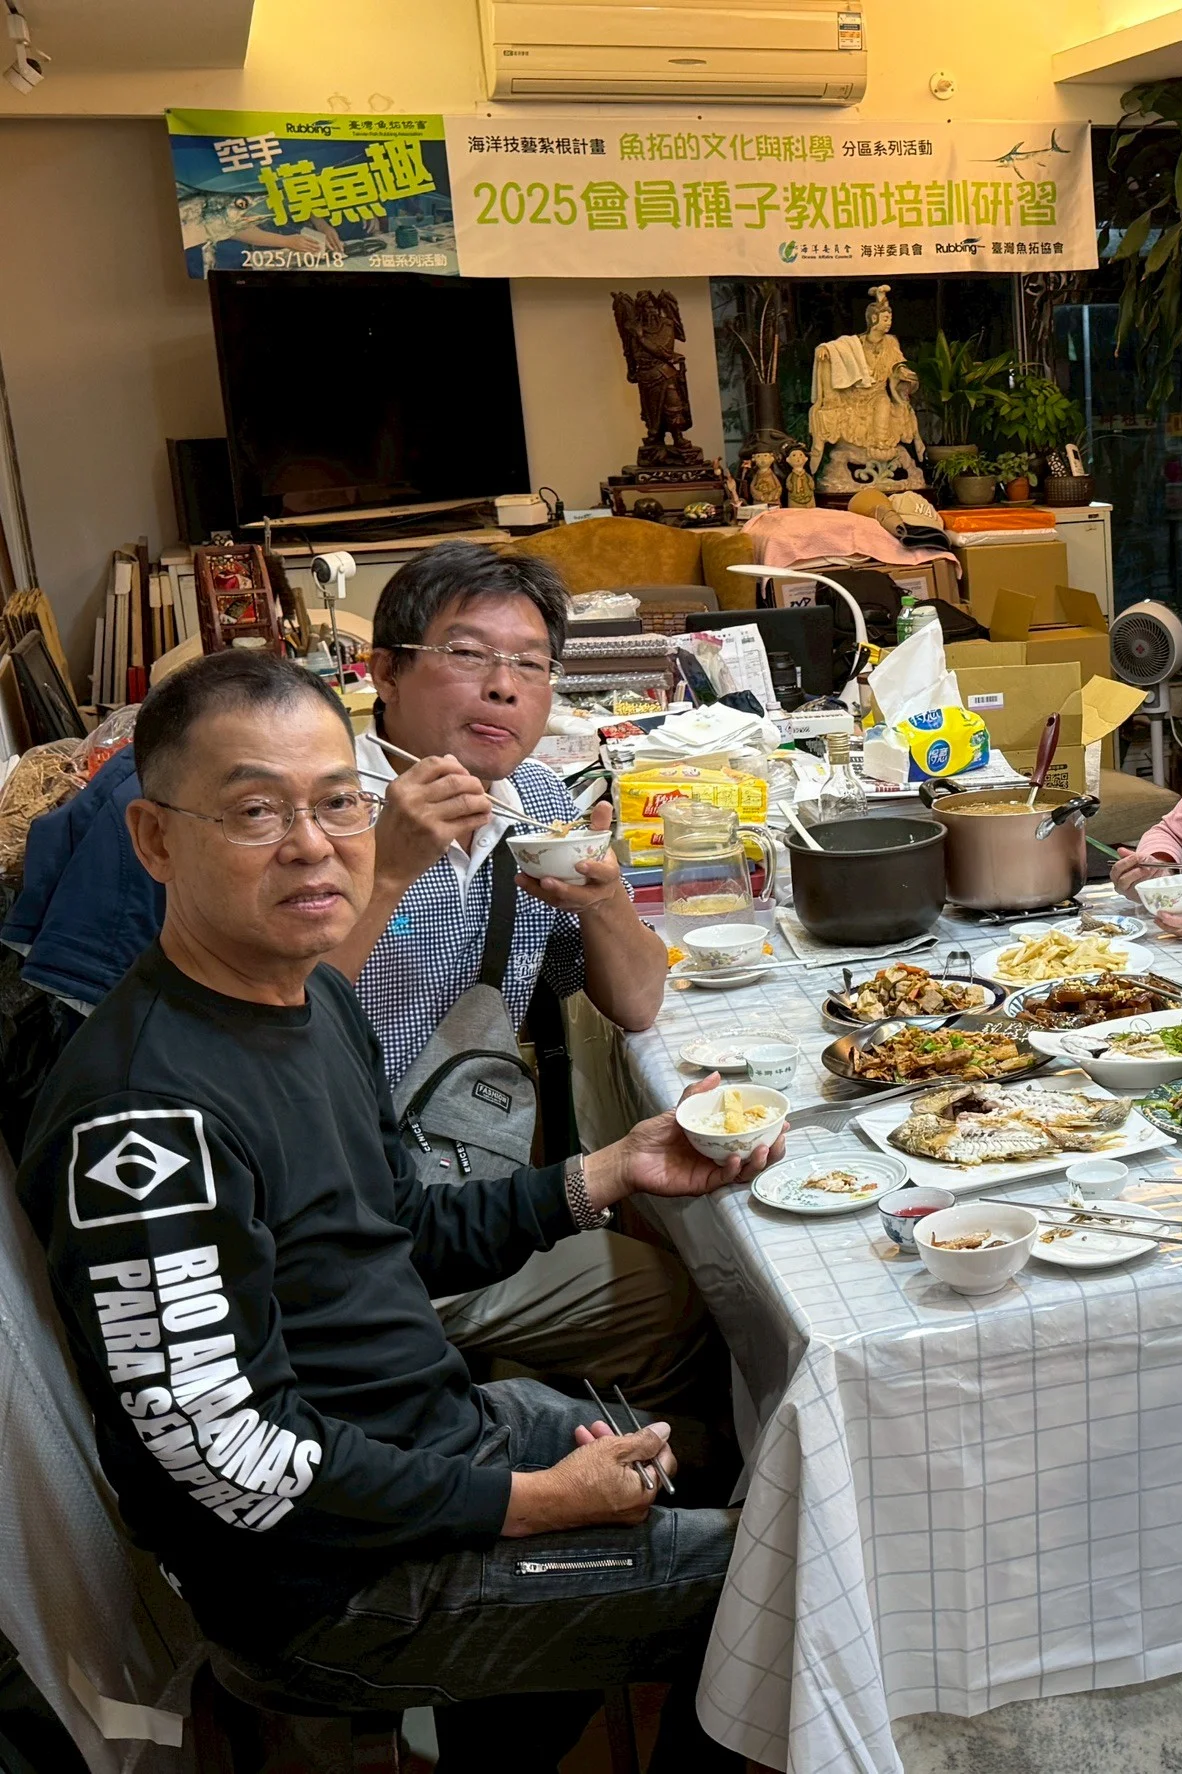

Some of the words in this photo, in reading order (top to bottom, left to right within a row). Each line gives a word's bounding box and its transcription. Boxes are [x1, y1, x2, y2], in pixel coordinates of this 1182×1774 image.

[286, 120, 333, 136] Rubbing
[213, 132, 283, 173] 空手
[467, 135, 607, 156] 海洋技藝紮根計畫
[619, 131, 835, 162] 魚拓的文化與科學
[841, 139, 933, 157] 分區系列活動
[258, 138, 437, 228] 摸魚趣
[474, 179, 1057, 232] 2025會員種子教師培訓研習
[241, 251, 345, 268] 2025/10/18
[368, 252, 448, 268] 分區系列活動
[860, 244, 923, 257] 海洋委員會
[935, 241, 978, 256] Rubbing
[991, 242, 1064, 255] 臺灣魚拓協會
[153, 1244, 230, 1333] RIO
[88, 1258, 166, 1384] PARA
